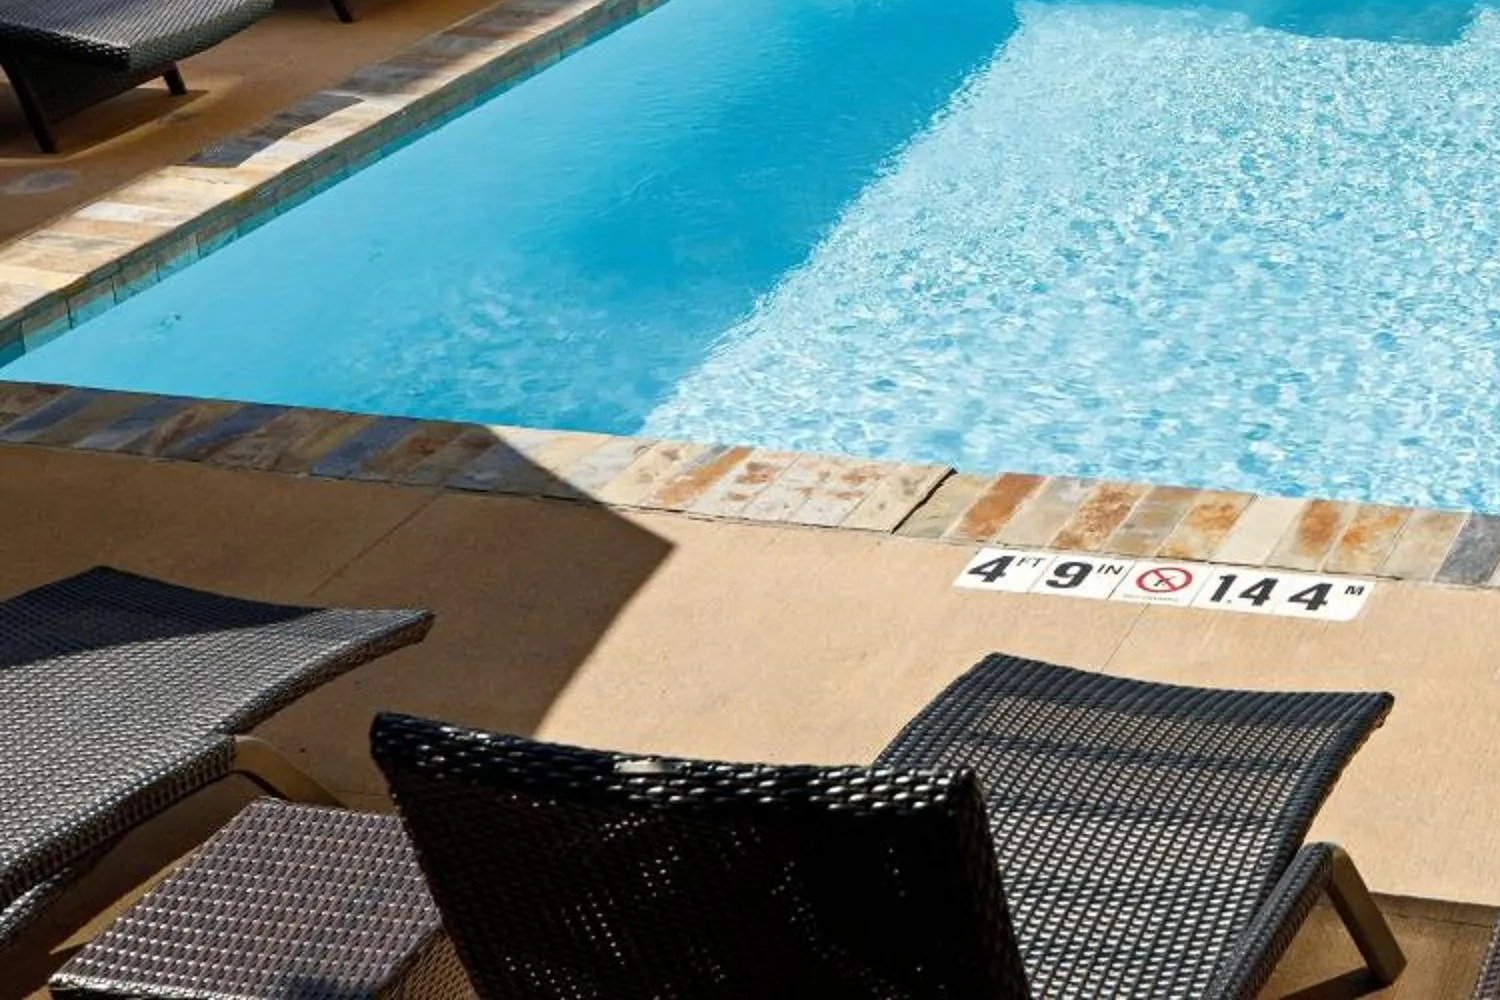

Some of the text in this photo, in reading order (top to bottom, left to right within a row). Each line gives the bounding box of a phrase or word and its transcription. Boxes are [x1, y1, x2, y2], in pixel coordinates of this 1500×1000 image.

[968, 555, 1015, 582] 4
[1016, 557, 1047, 568] FT
[1045, 561, 1094, 588] 9
[1097, 563, 1124, 575] IN
[1343, 585, 1366, 596] M
